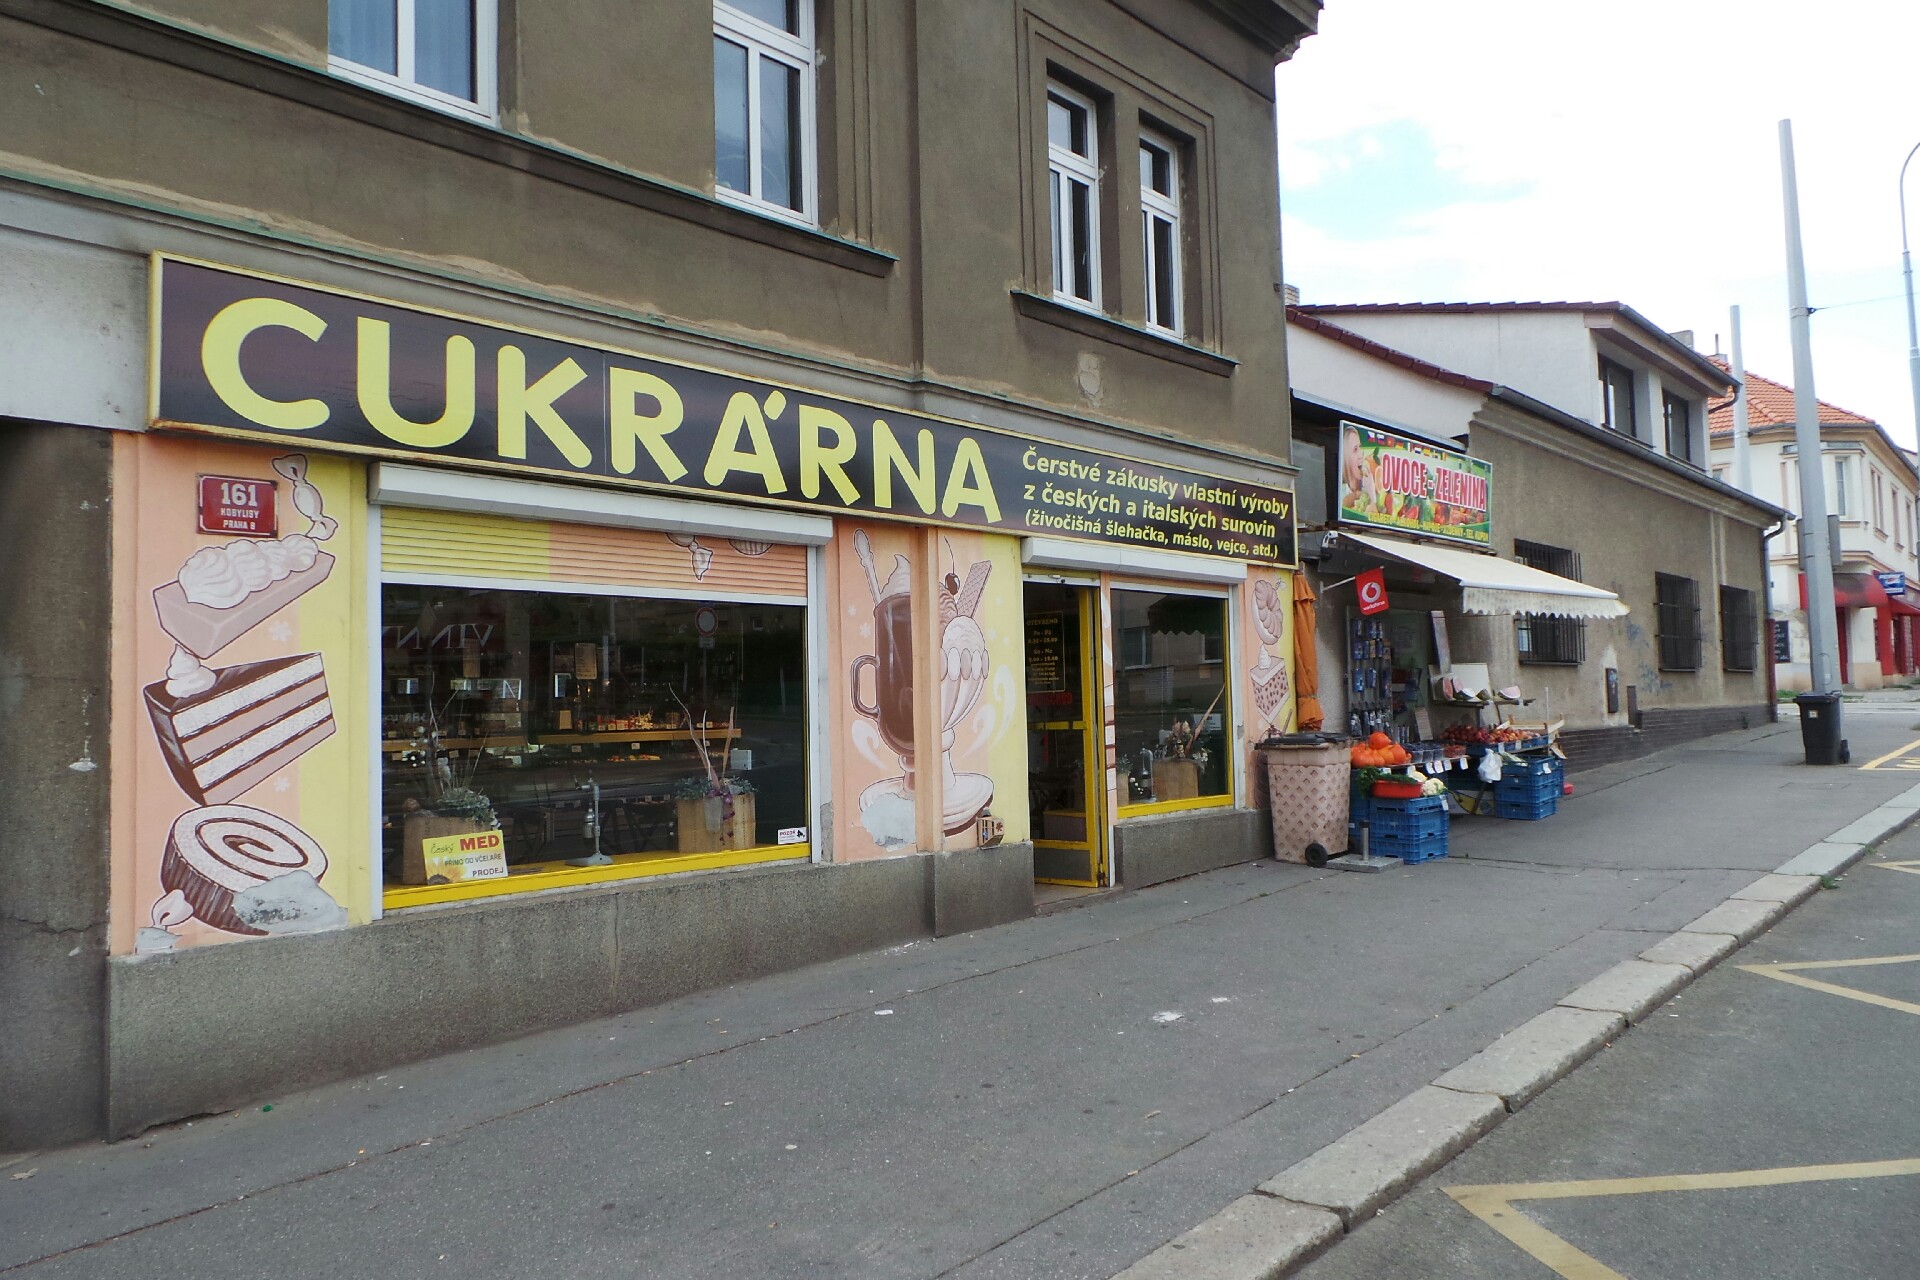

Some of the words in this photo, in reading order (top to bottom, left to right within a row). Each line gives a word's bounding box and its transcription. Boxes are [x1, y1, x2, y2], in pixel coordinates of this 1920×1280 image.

[201, 297, 1002, 524] CUKRÁRNA
[221, 482, 258, 507] 161
[1022, 445, 1100, 482] Čerstvé
[1106, 469, 1178, 500] zákusky
[1183, 483, 1237, 507] vlastní
[1240, 495, 1289, 520] výroby
[1382, 453, 1427, 498] OVOCE
[1434, 467, 1487, 512] ZELENINA
[220, 508, 260, 519] KOBYLISY
[223, 520, 248, 530] PRAHA
[1023, 485, 1034, 501] z
[1042, 482, 1120, 514] českých
[1125, 501, 1136, 516] a
[1143, 500, 1216, 531] italských
[1222, 516, 1276, 538] surovin
[1025, 509, 1101, 535] (živočišná
[1106, 520, 1169, 545] šlehačka,
[1173, 533, 1213, 550] máslo,
[1217, 539, 1250, 556] vejce,
[1253, 543, 1279, 560] atd.)
[430, 843, 454, 854] Český
[460, 835, 500, 851] MED
[472, 867, 504, 878] PRODEJ
